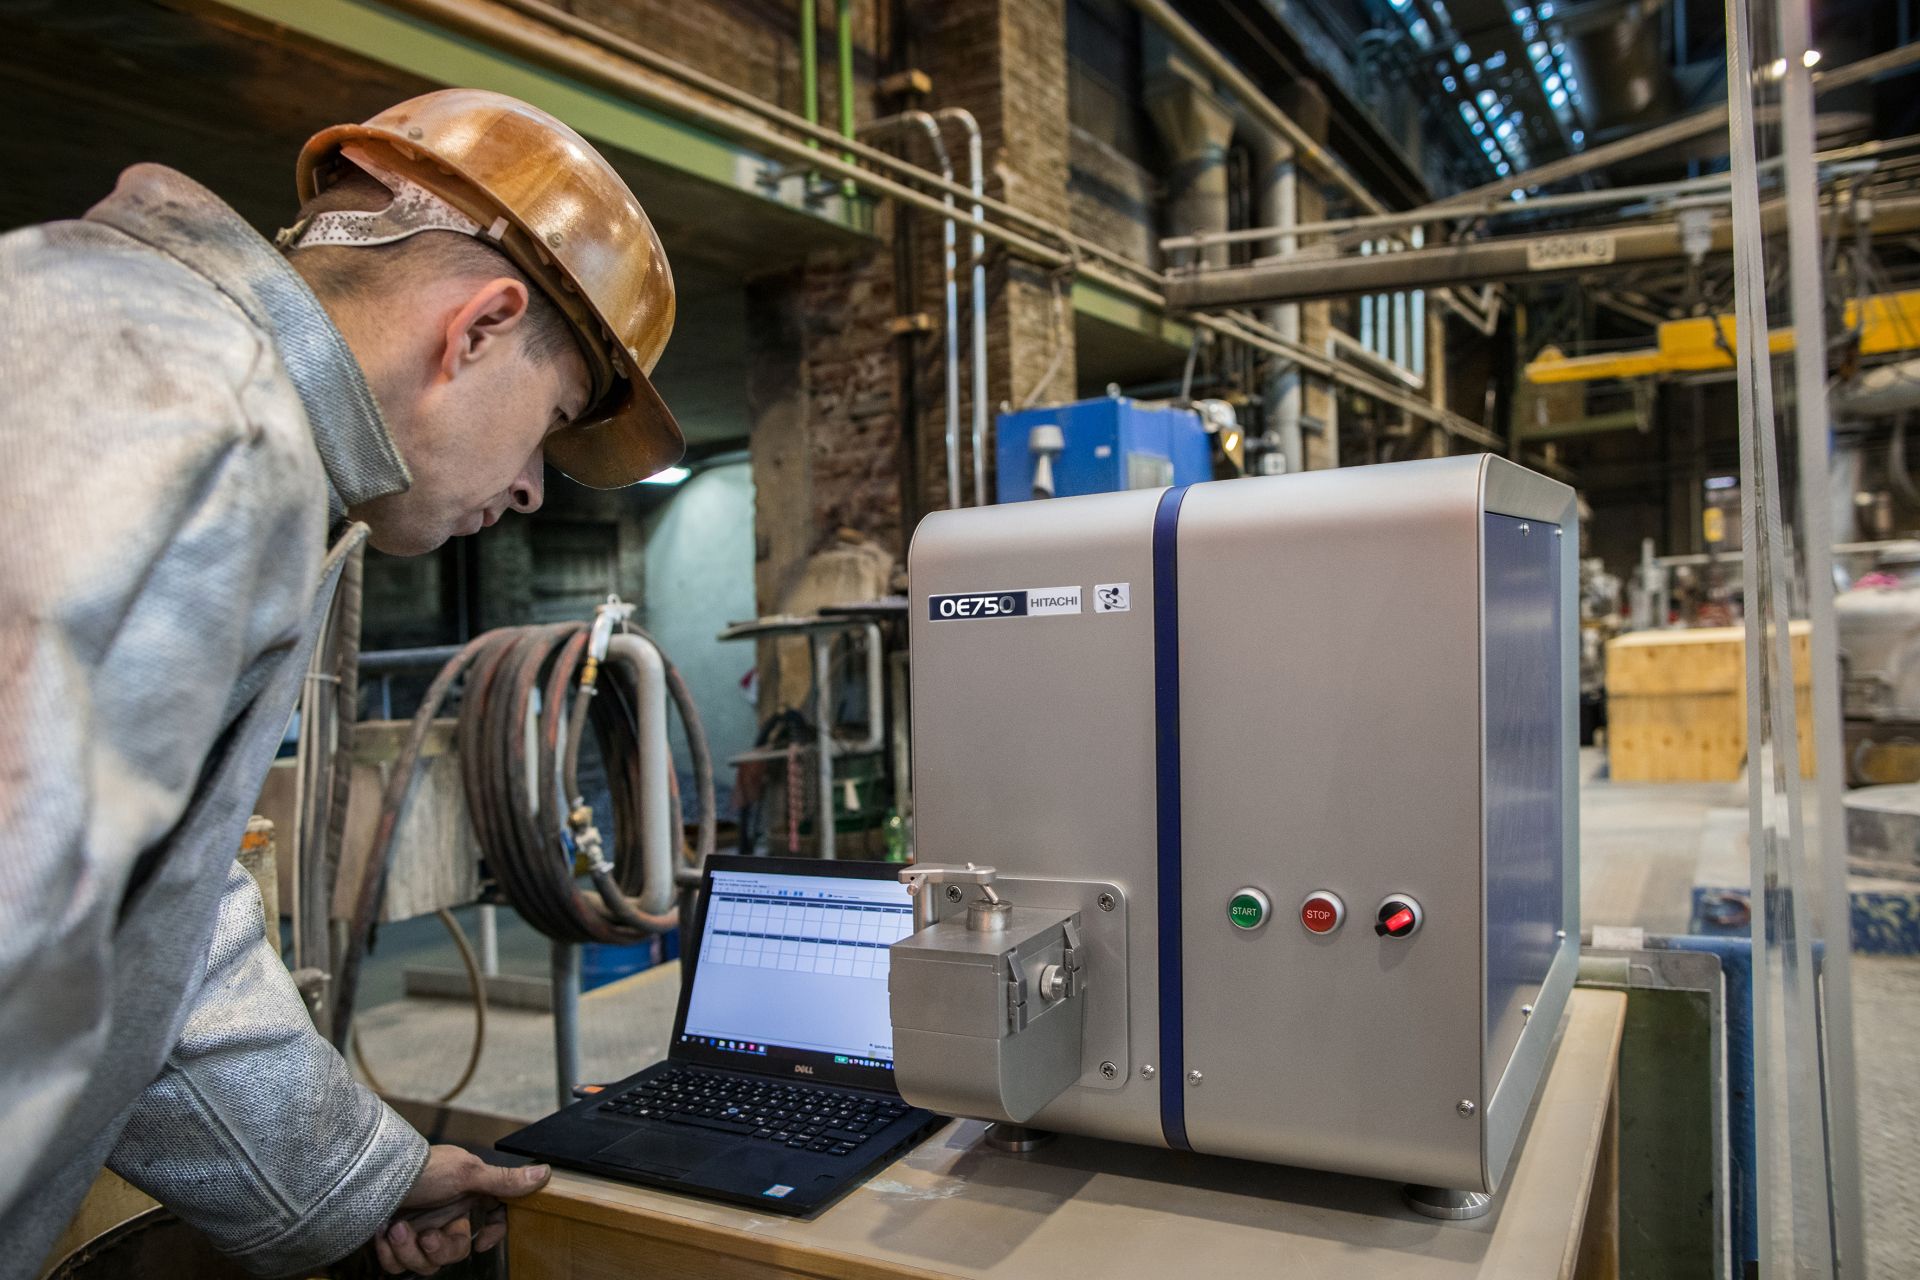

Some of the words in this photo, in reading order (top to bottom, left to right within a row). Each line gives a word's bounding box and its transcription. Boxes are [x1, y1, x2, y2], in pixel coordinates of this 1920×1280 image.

[939, 595, 1016, 617] OE750
[1030, 596, 1078, 609] HITACHI
[1232, 906, 1257, 917] START
[1306, 909, 1331, 920] STOP
[794, 1064, 814, 1075] DELL
